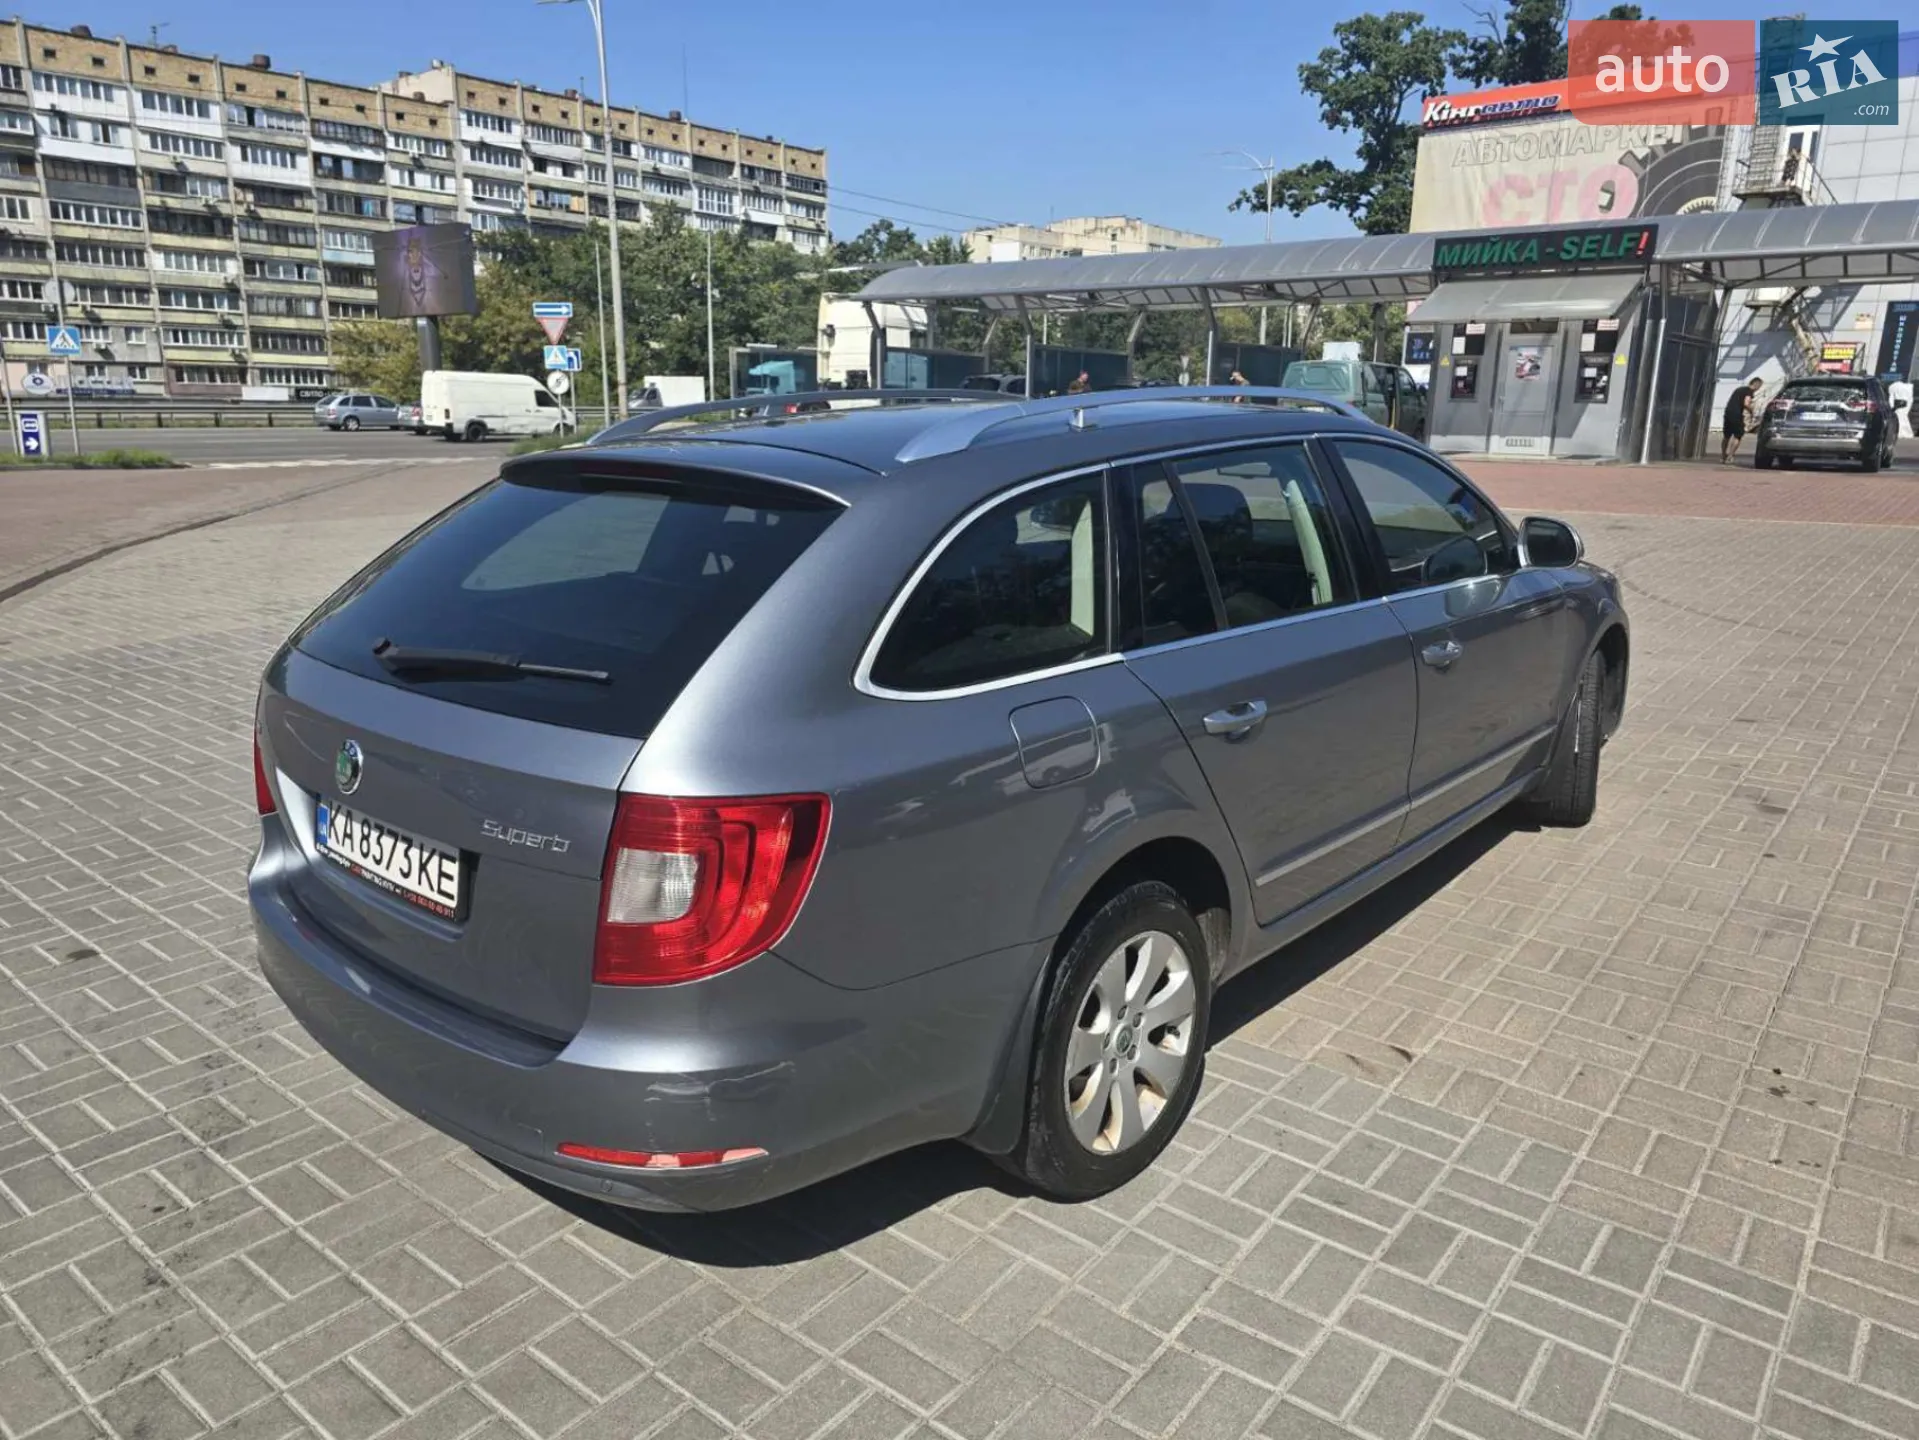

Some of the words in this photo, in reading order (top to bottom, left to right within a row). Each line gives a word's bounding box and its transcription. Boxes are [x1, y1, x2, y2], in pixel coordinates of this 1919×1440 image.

[1482, 163, 1639, 226] СТО
[1436, 237, 1539, 267] МИЙКА
[1559, 231, 1649, 261] SELF!
[480, 818, 571, 853] Superb
